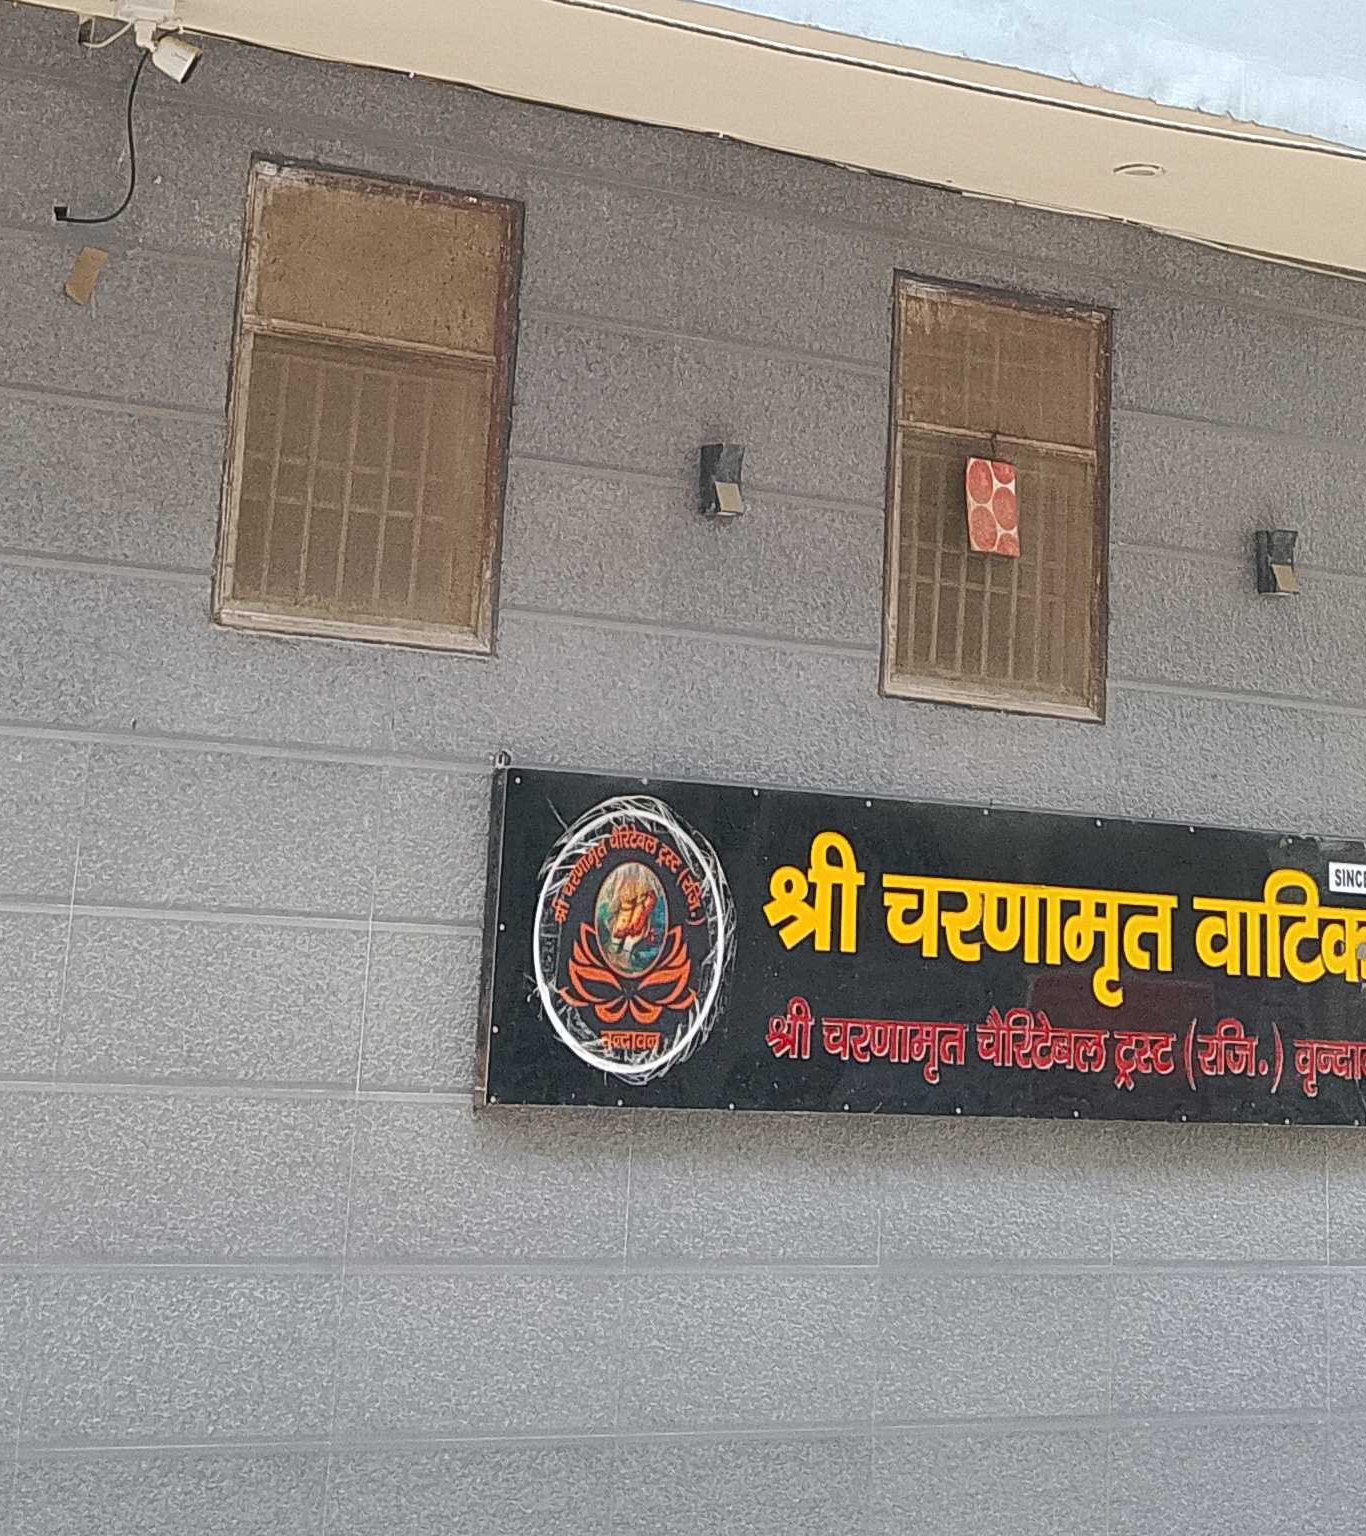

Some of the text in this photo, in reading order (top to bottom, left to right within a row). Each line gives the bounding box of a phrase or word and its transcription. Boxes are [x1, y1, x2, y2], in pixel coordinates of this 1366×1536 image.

[763, 831, 866, 953] श्री
[882, 873, 1178, 1008] चरणामृत
[765, 996, 814, 1059] श्री
[822, 1017, 968, 1084] चरणामृत
[976, 1007, 1110, 1074] चैरिटेबल
[1113, 1030, 1177, 1092] ट्रस्ट
[1185, 1017, 1283, 1094] (रजि.)
